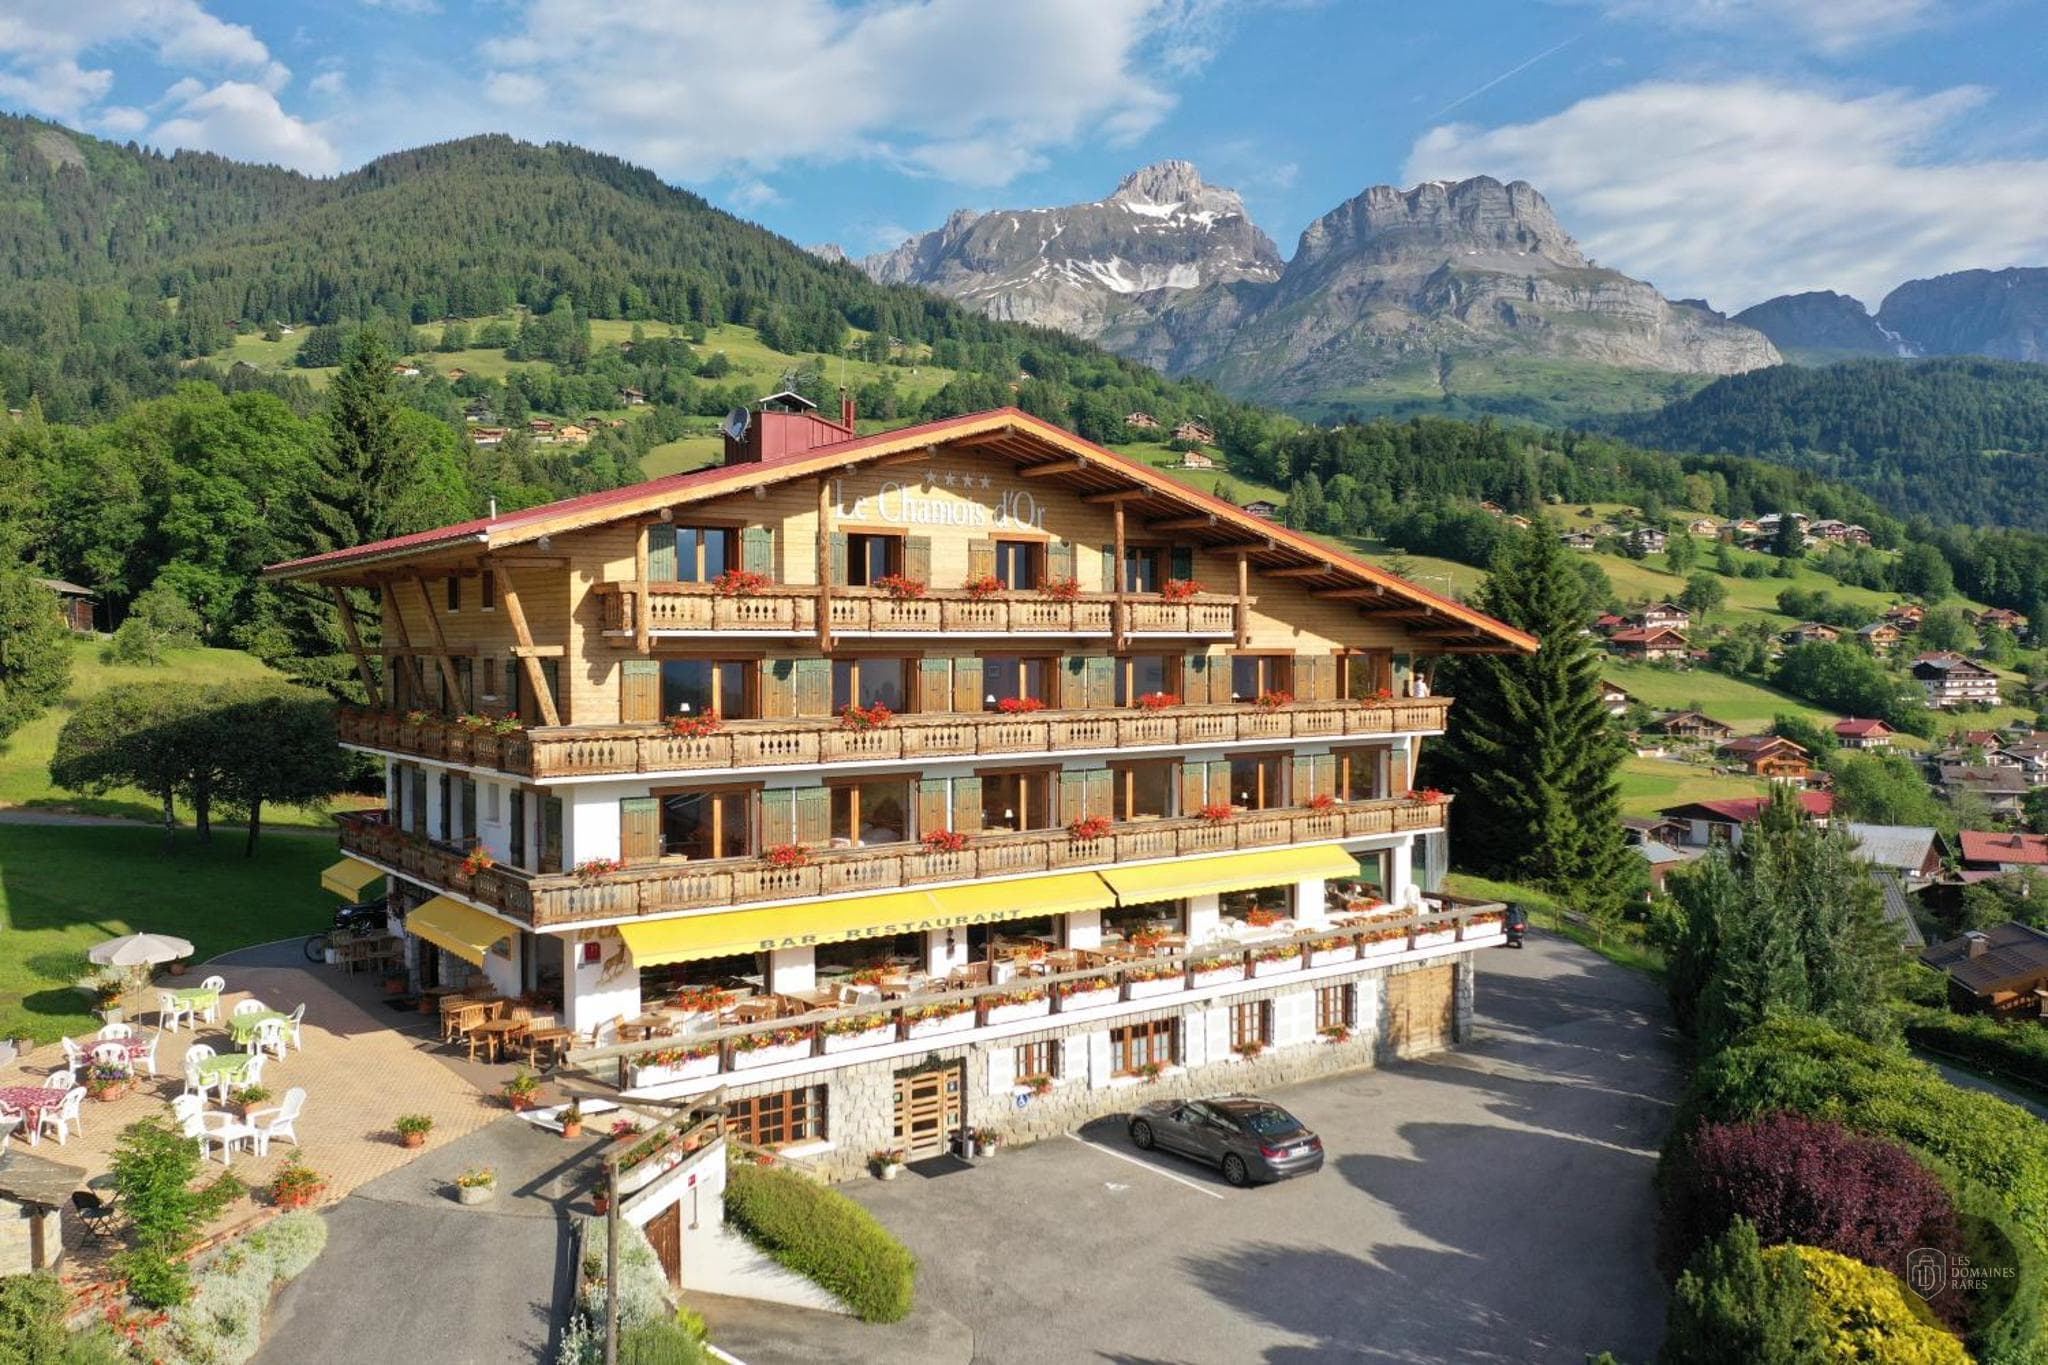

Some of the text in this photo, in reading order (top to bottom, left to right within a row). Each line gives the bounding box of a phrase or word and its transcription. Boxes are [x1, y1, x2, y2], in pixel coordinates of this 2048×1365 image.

[835, 478, 868, 520] Le
[878, 480, 986, 527] Chamois
[759, 934, 817, 950] BAR
[846, 908, 1021, 938] RESTAURANT
